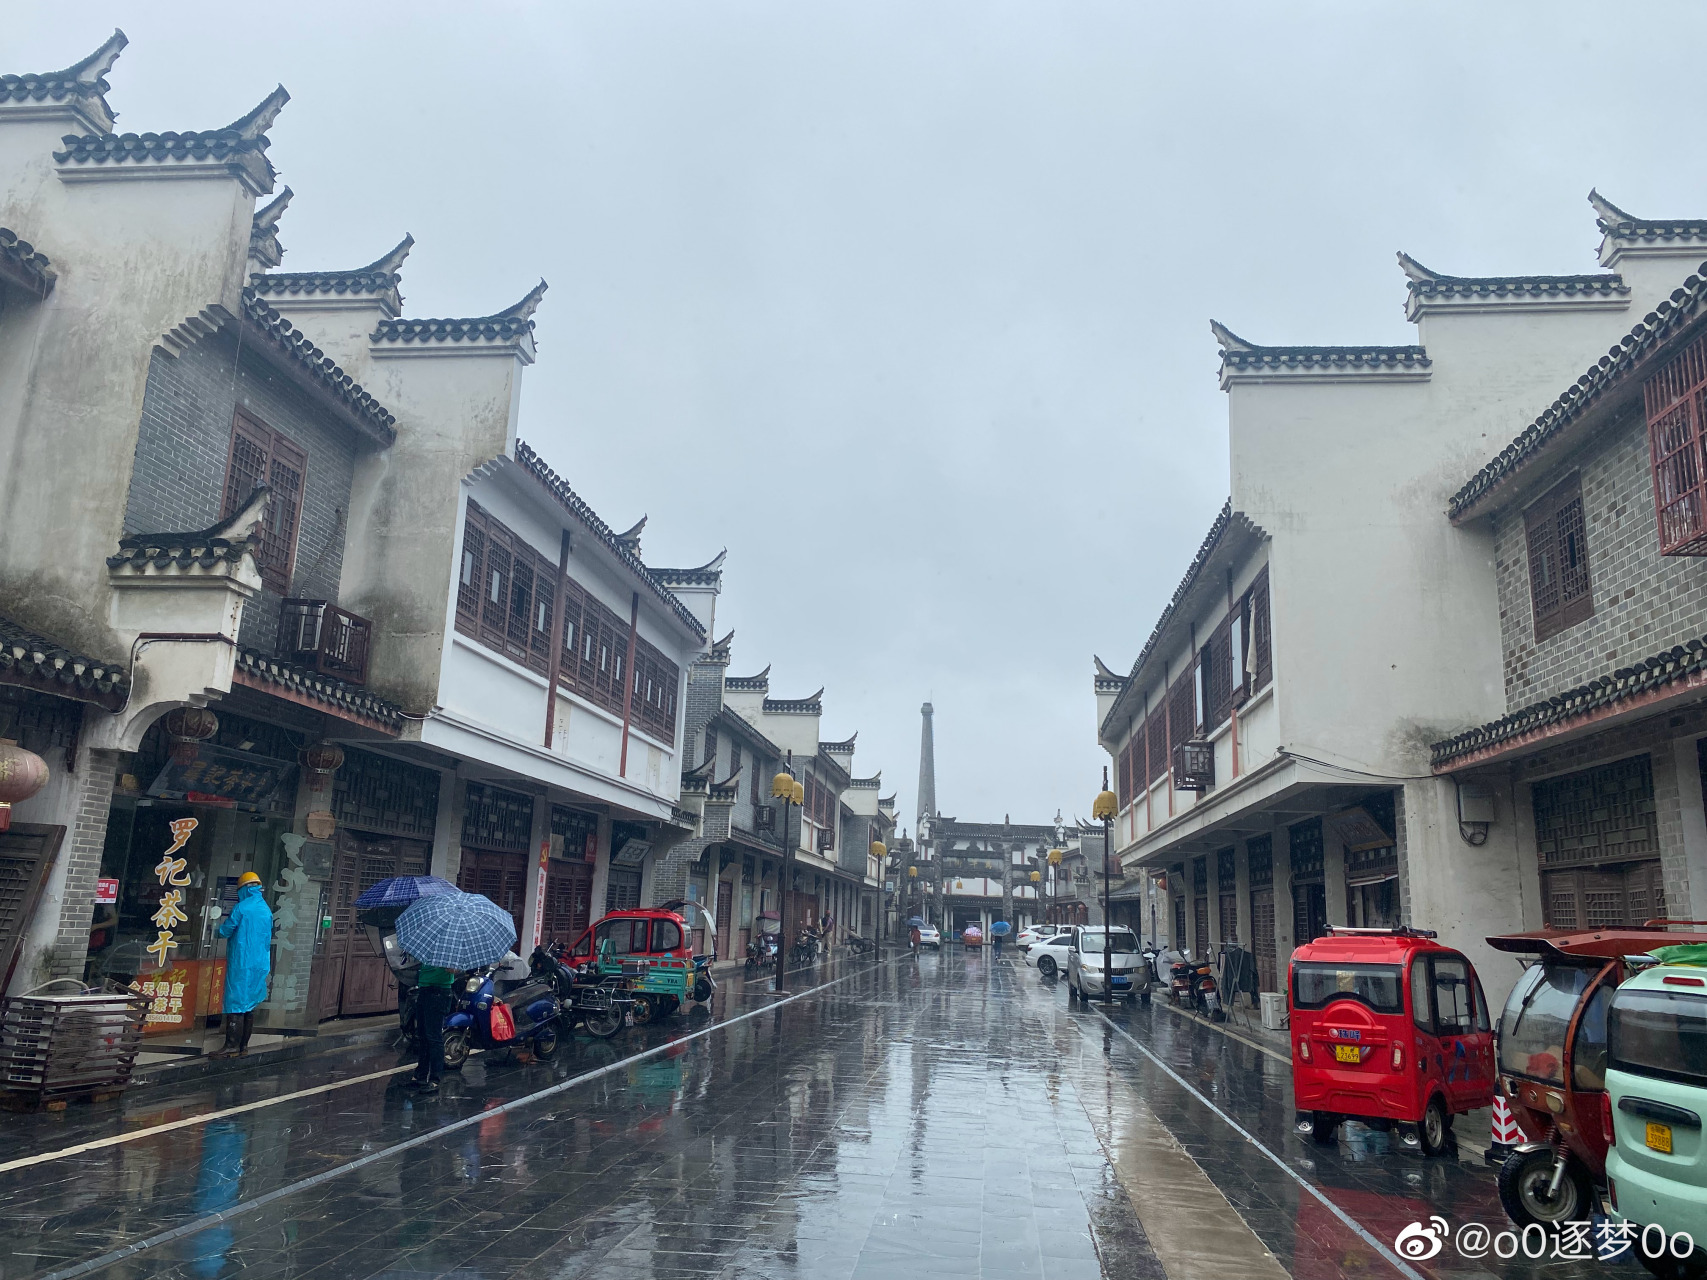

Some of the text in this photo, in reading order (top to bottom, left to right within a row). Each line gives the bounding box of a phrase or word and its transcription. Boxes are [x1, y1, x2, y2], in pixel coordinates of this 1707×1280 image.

[147, 817, 198, 967] 罗记茶干
[128, 980, 184, 997] 今天供应
